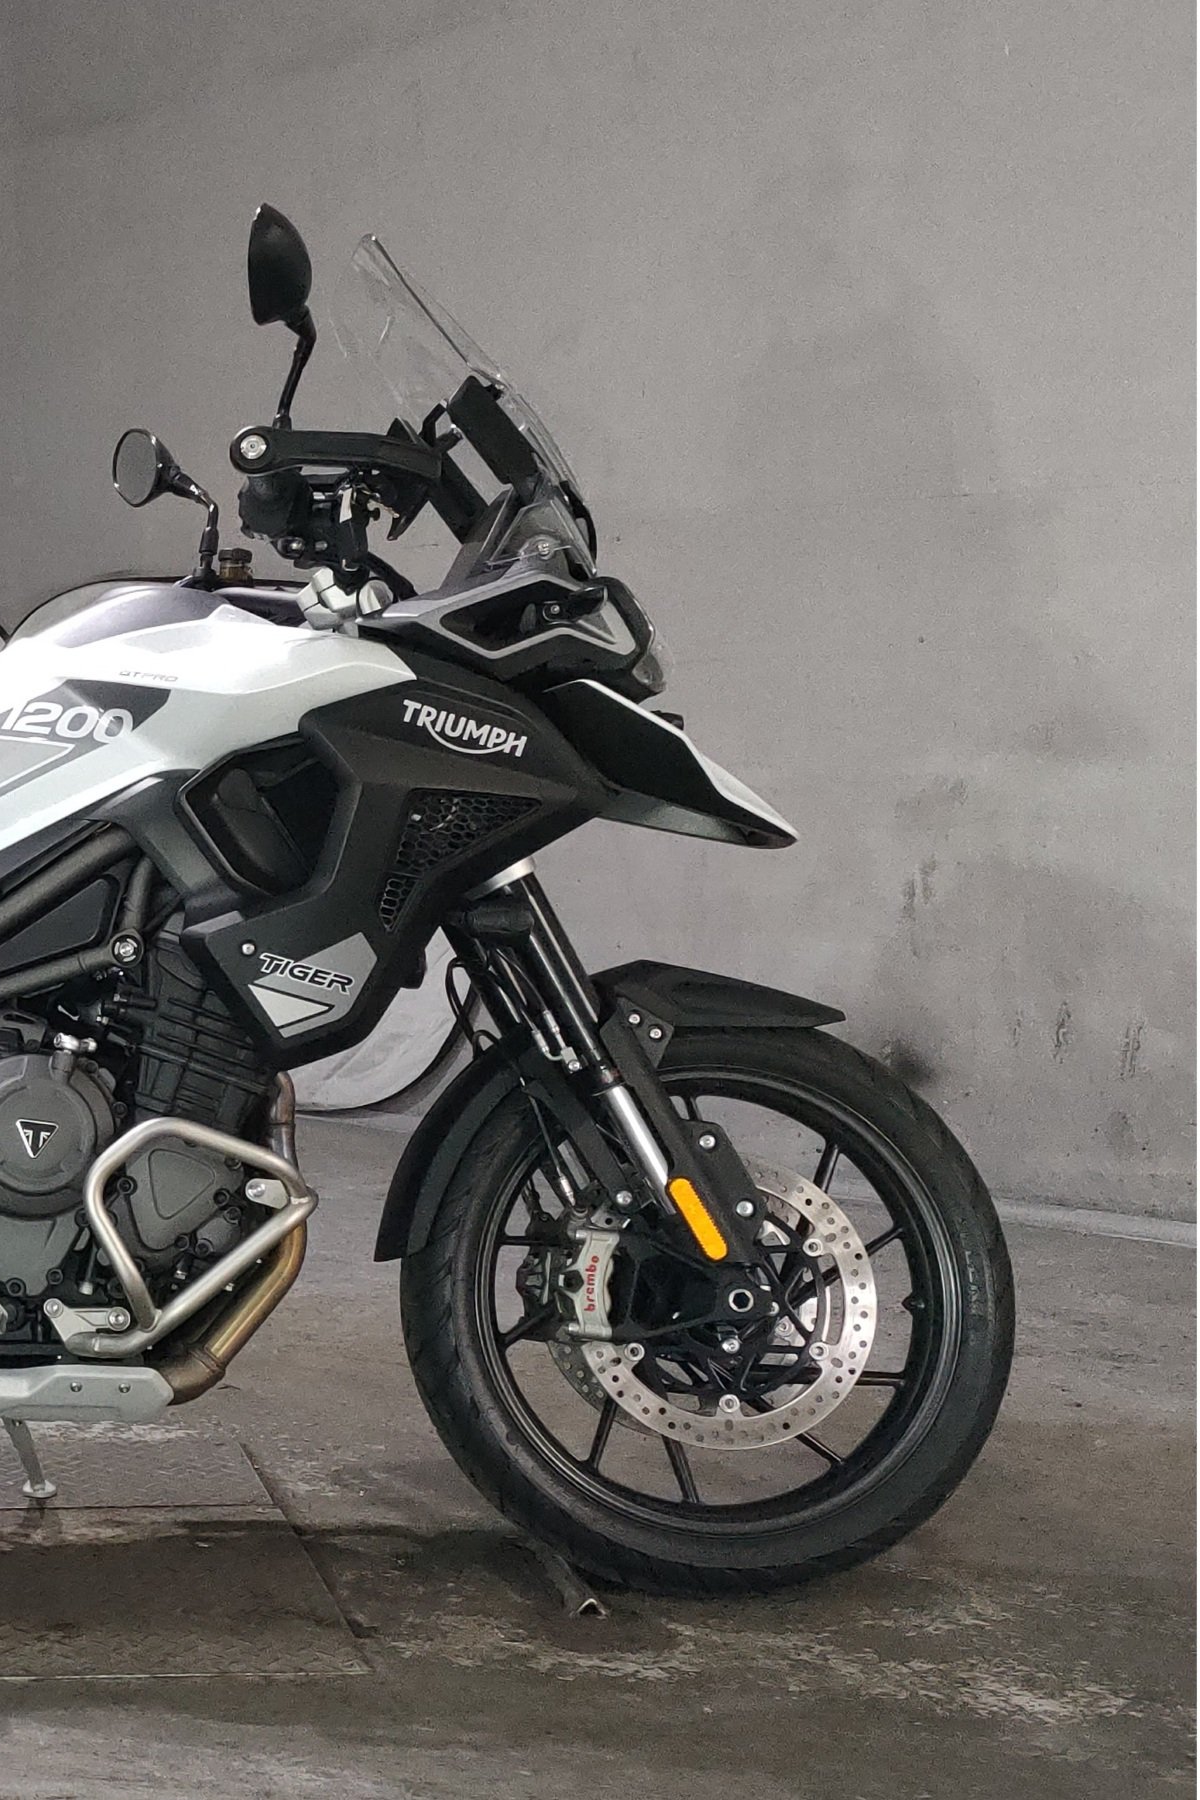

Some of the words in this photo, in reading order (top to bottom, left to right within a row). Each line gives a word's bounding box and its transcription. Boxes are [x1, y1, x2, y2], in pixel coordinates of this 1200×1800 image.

[0, 701, 134, 744] 1200
[403, 699, 528, 757] TRIUMPH
[259, 952, 355, 996] TIGER
[584, 1255, 600, 1312] brembo
